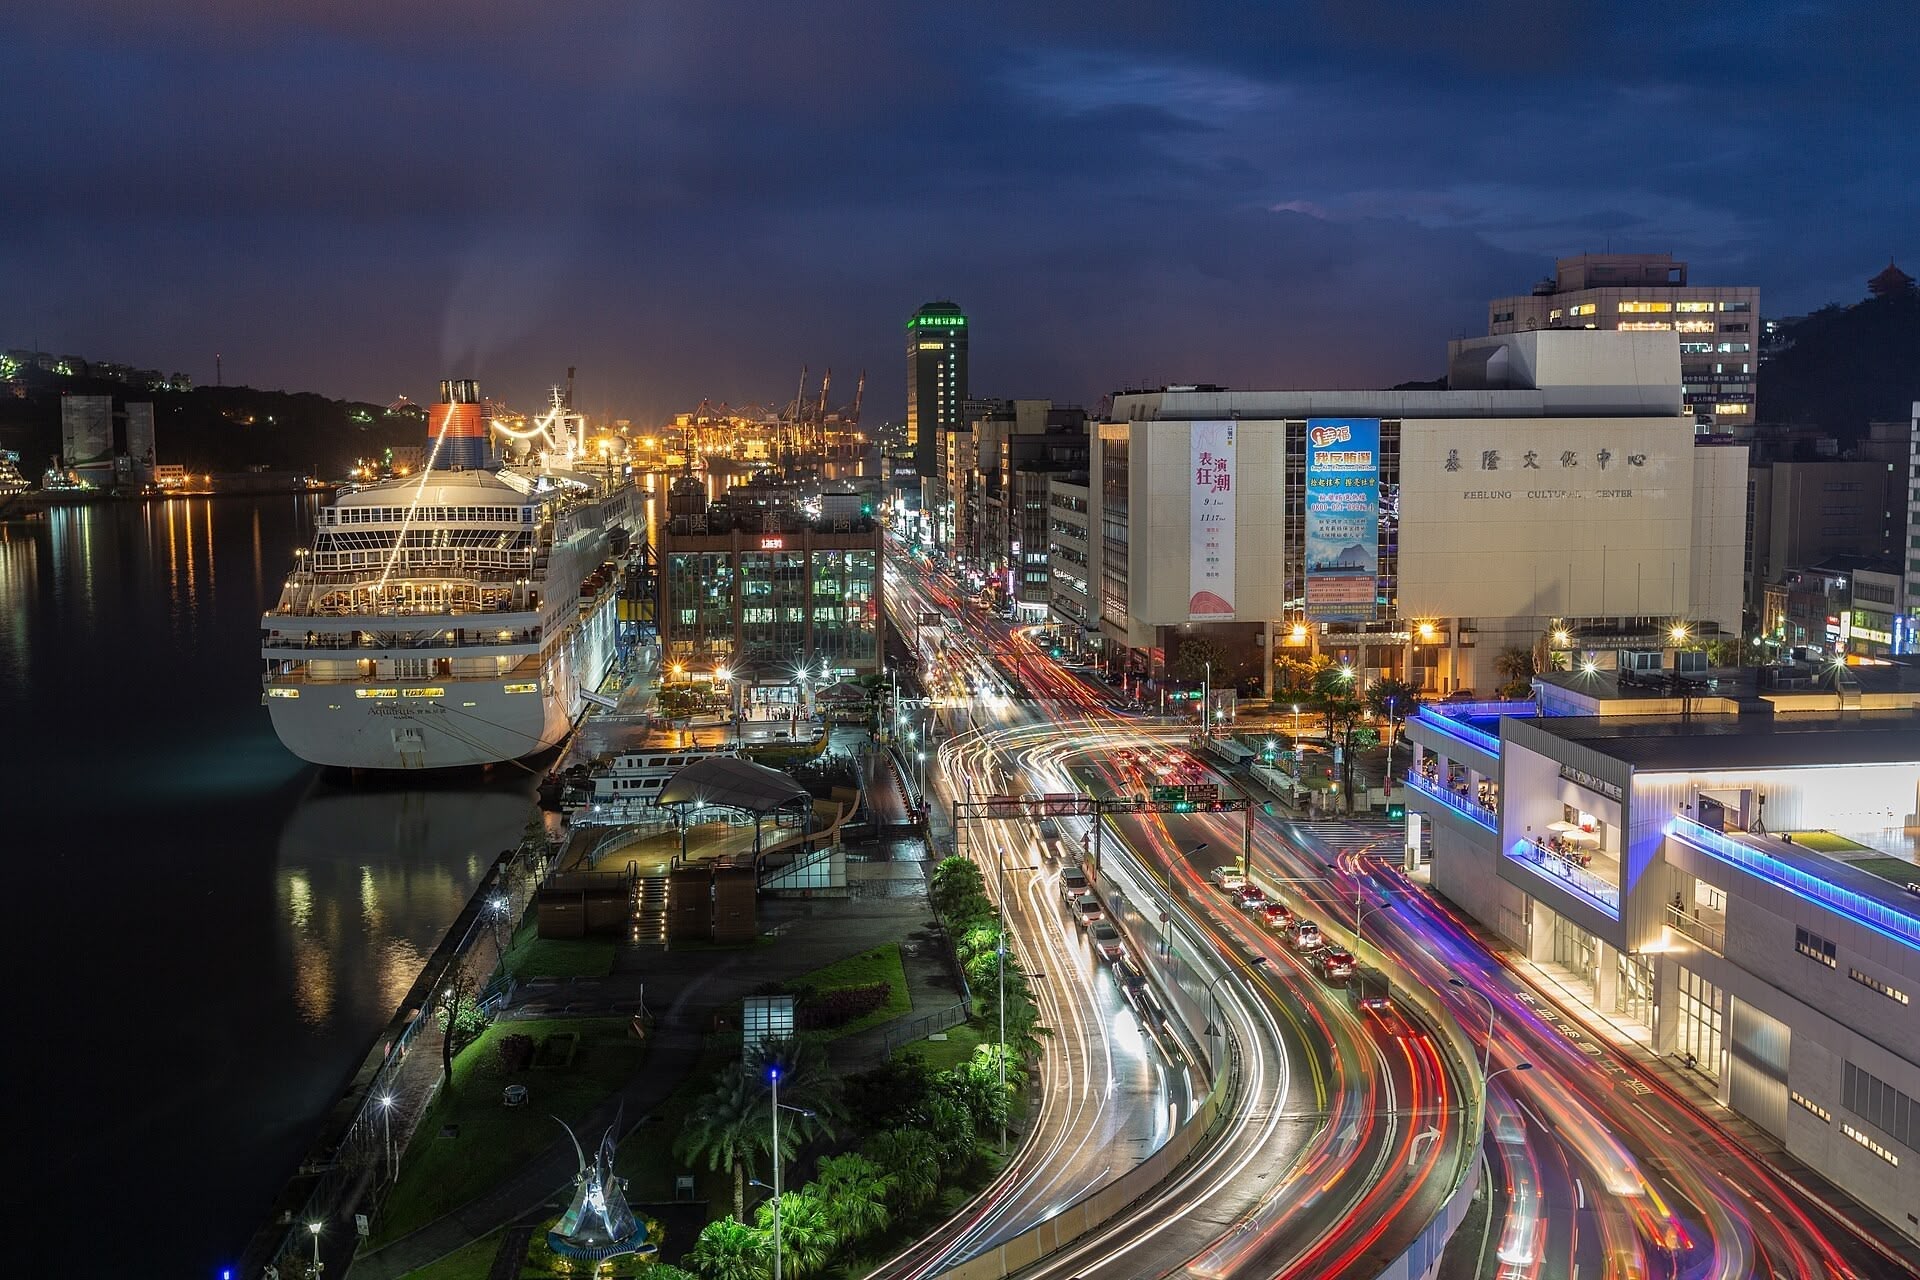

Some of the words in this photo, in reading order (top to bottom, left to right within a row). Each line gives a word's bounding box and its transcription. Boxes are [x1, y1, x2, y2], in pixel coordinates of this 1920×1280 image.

[920, 317, 964, 325] 長榮桂冠酒店
[1315, 452, 1371, 464] 我反賄選
[1444, 448, 1647, 472] 基隆文化中心
[1463, 491, 1512, 500] KEELUNG
[1597, 489, 1633, 499] CENTER
